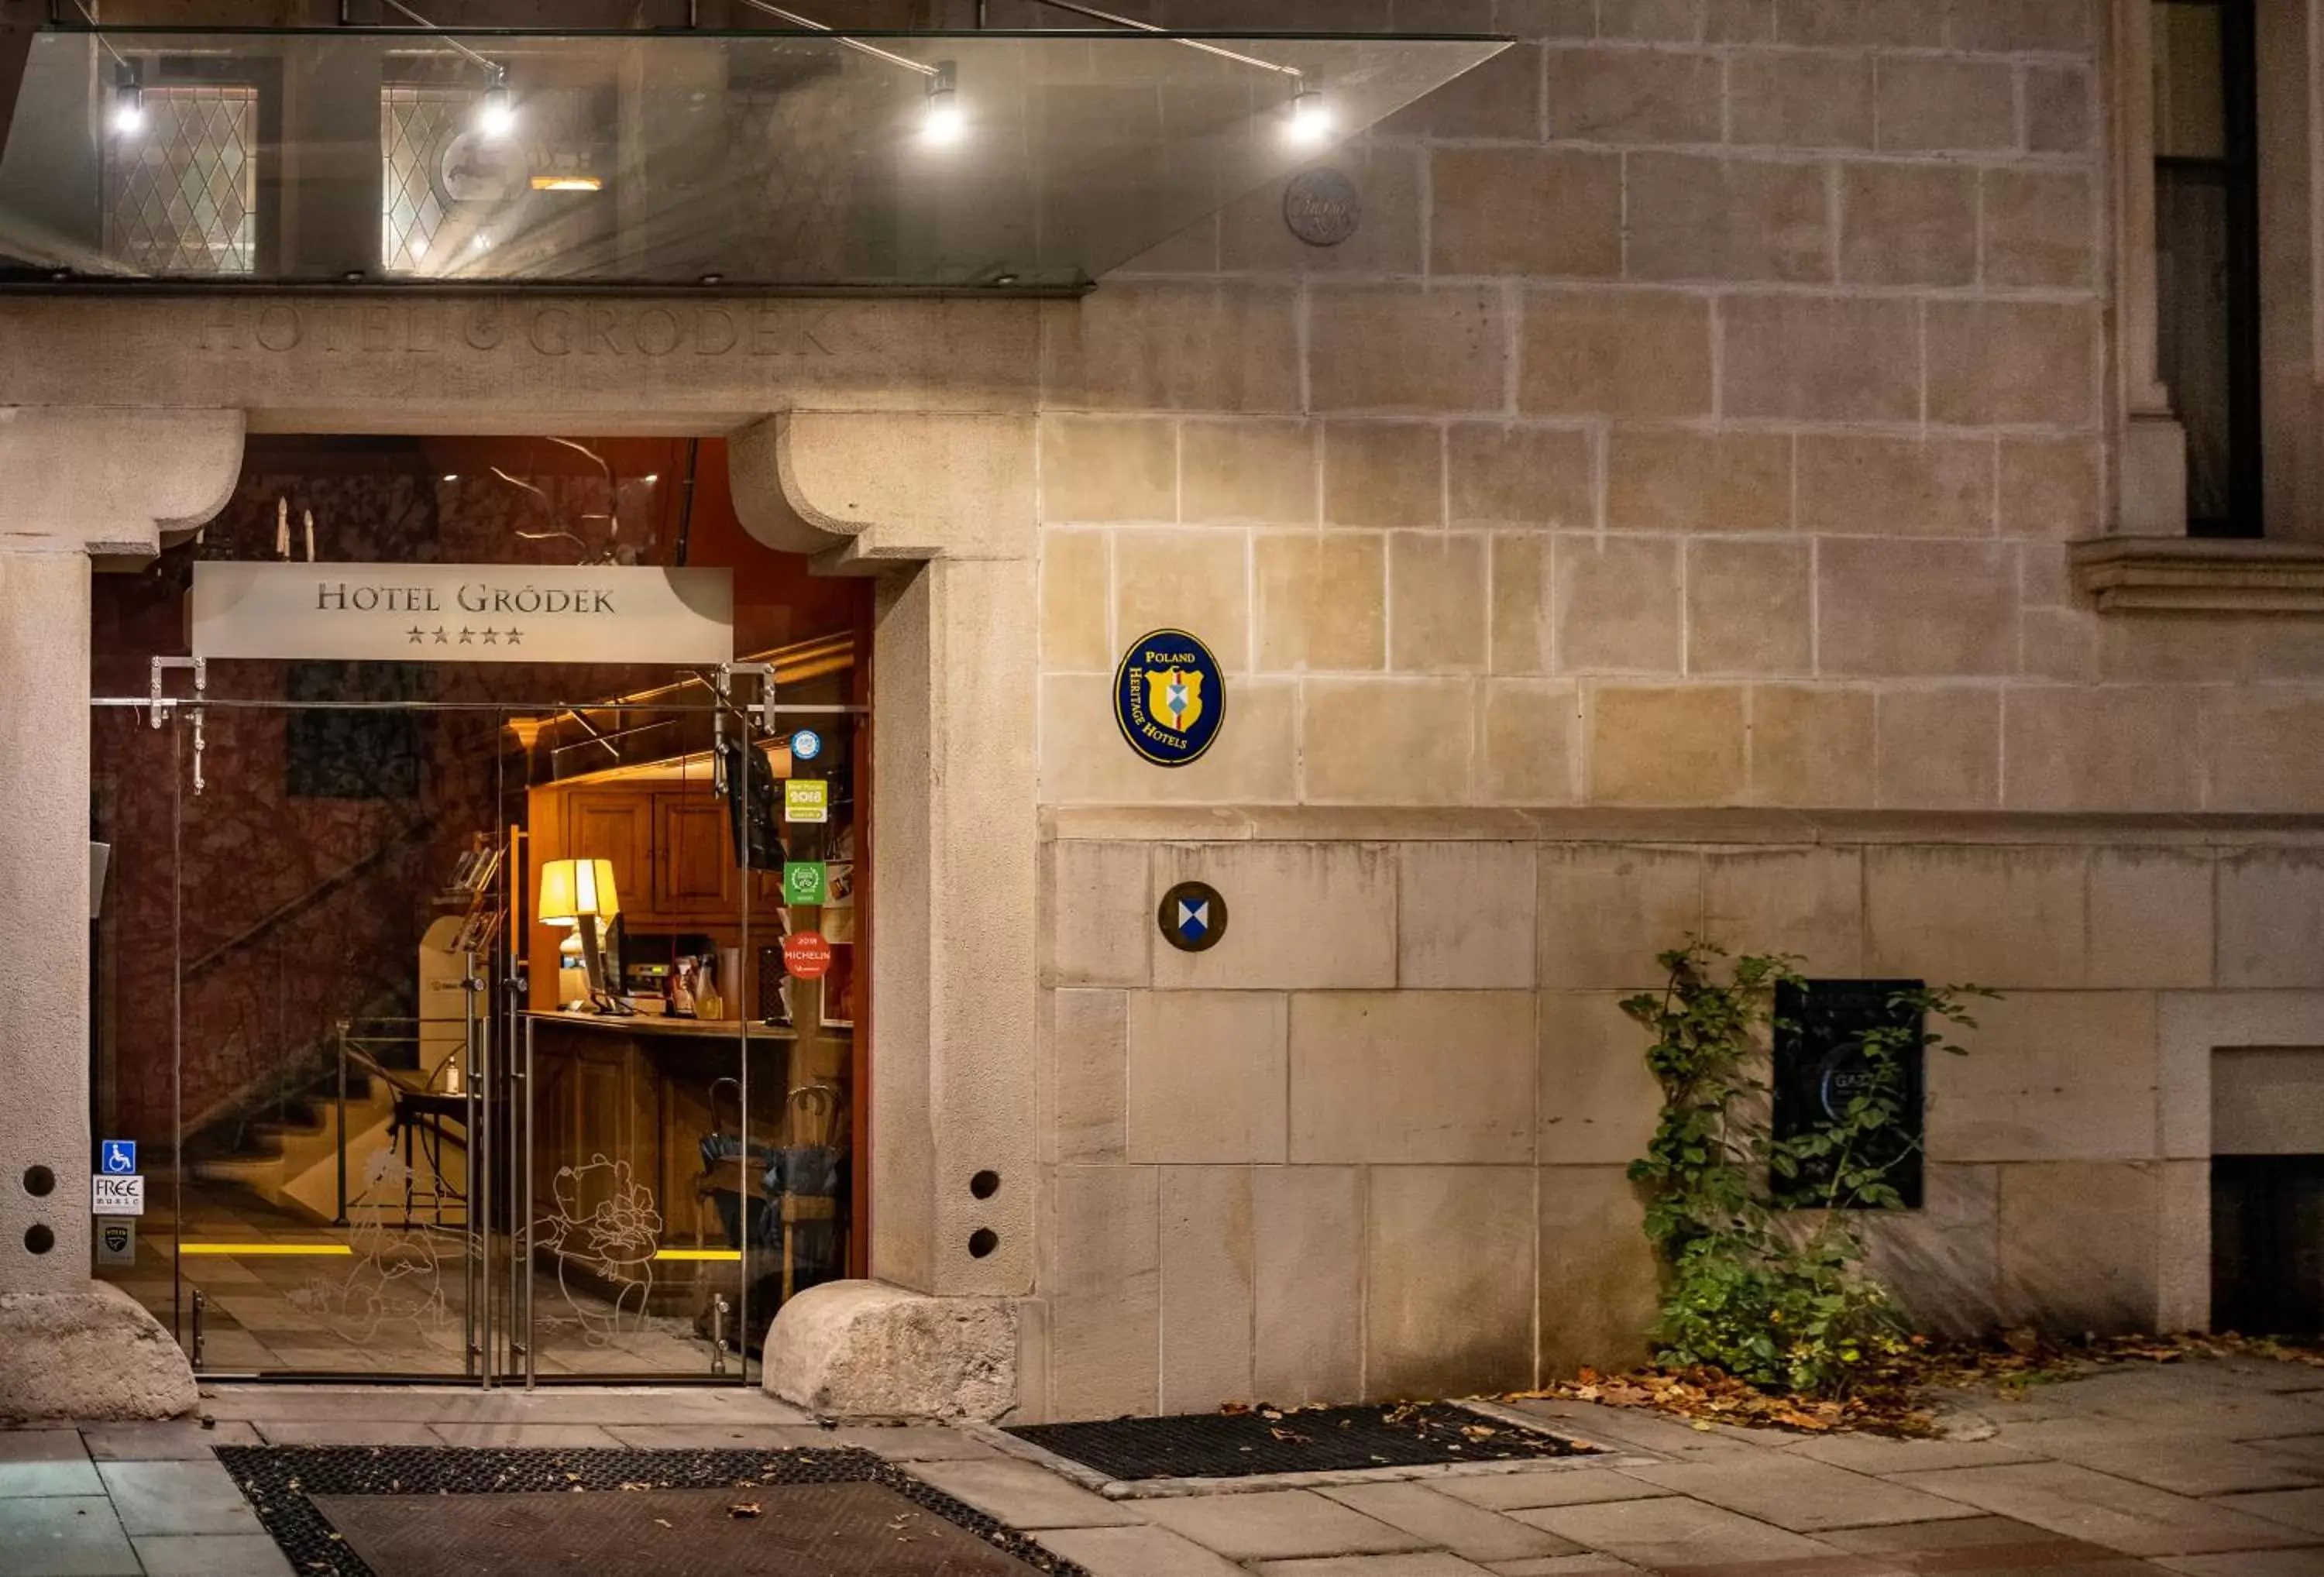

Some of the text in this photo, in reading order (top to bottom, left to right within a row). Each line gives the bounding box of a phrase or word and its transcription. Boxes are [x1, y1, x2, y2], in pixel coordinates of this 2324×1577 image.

[315, 582, 615, 613] HOTEL GRÓDEK
[1145, 651, 1195, 663] POLAND
[1129, 667, 1188, 750] HERITAGE HOTELS
[785, 951, 830, 960] MICHELIN
[97, 1180, 139, 1196] FREE
